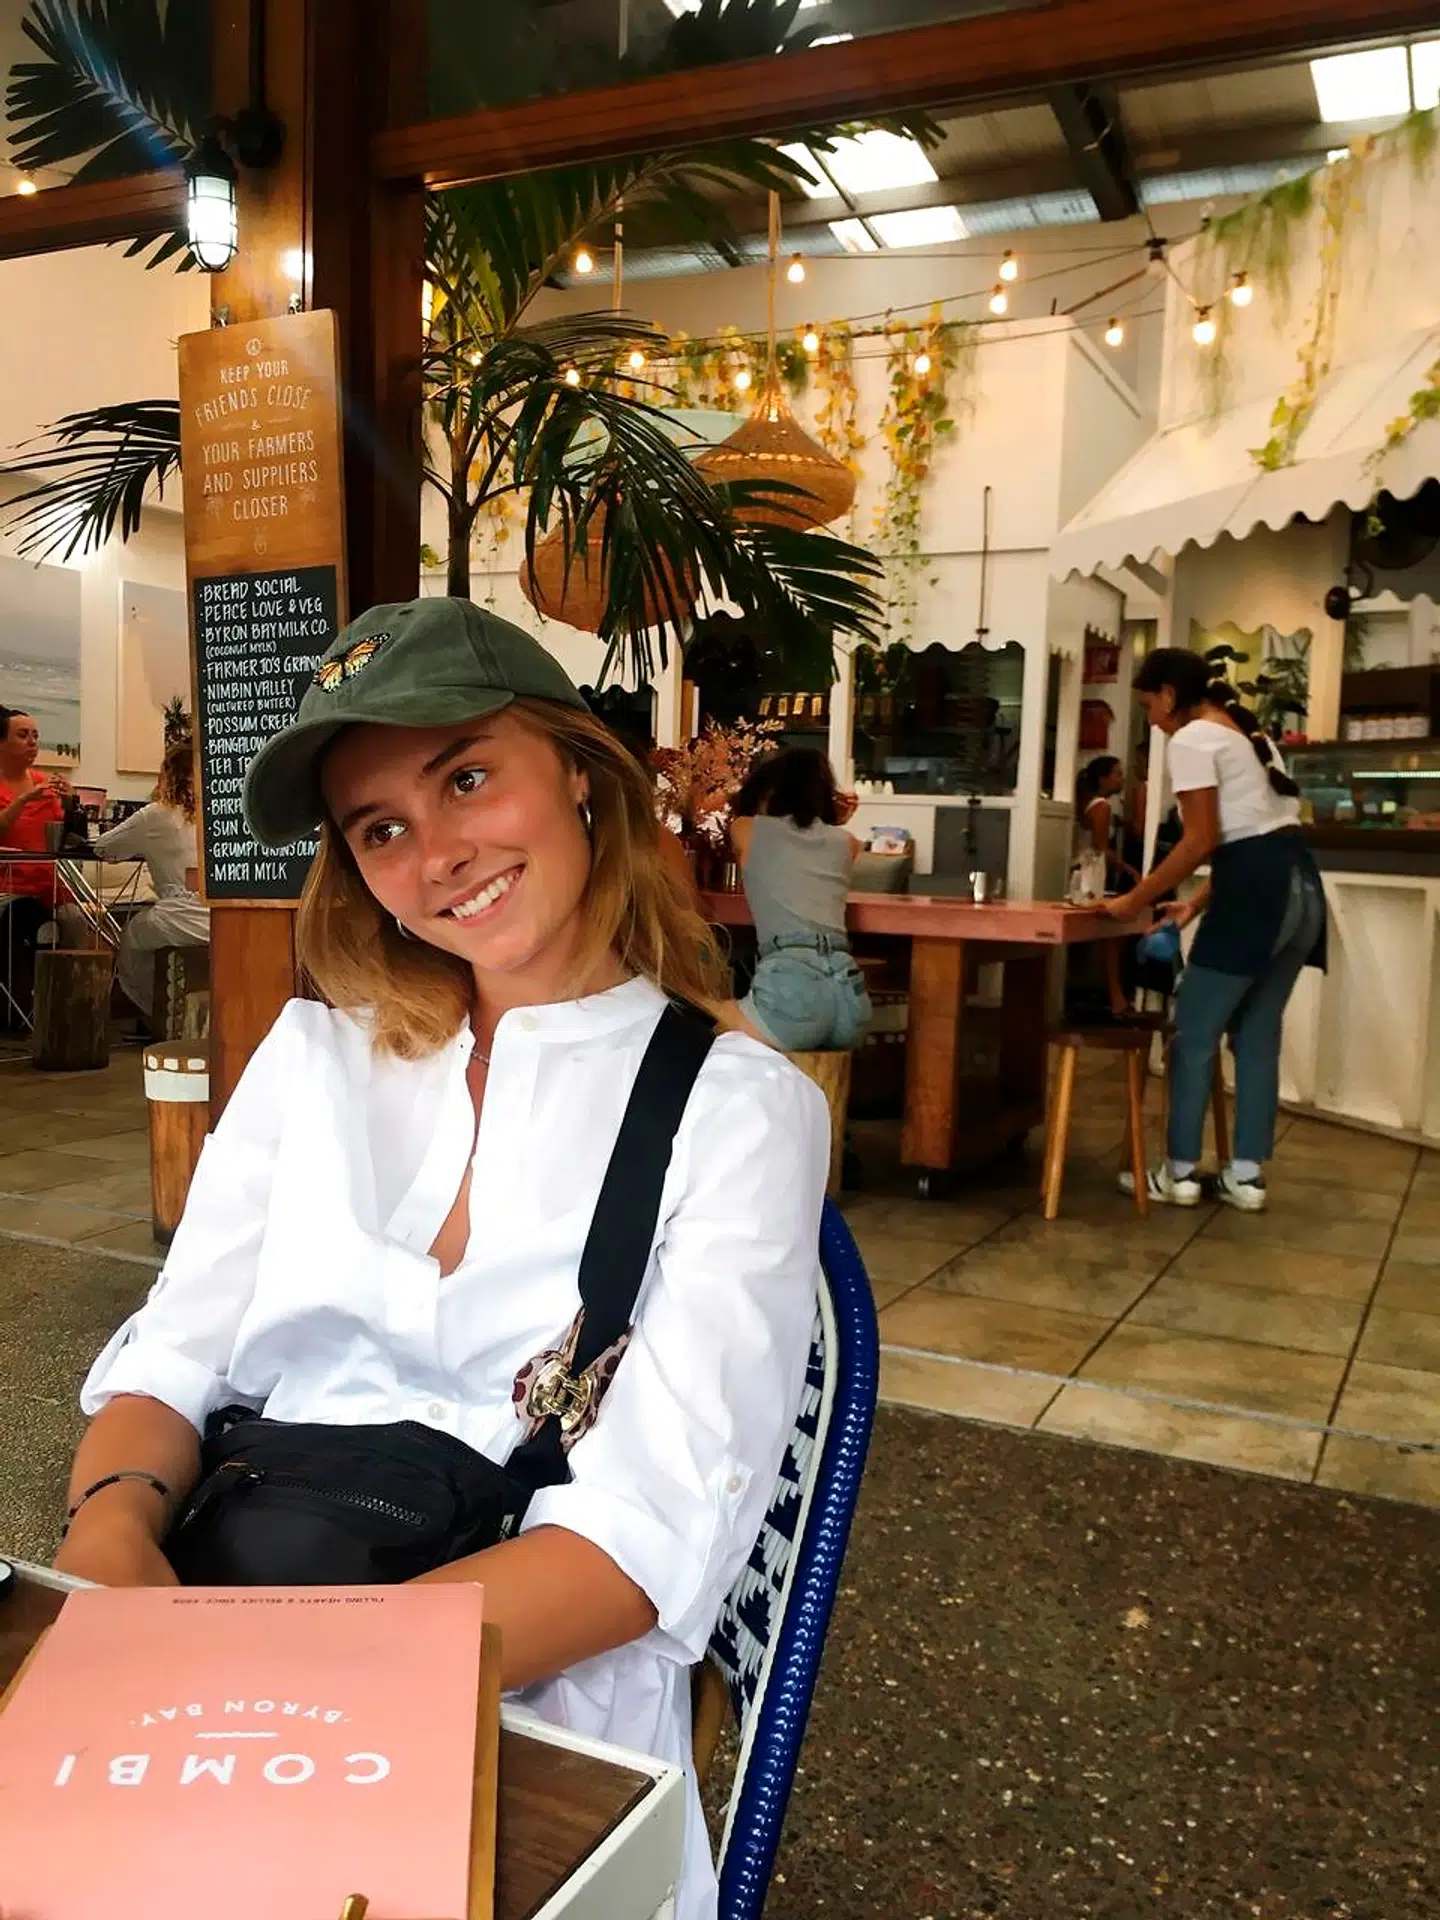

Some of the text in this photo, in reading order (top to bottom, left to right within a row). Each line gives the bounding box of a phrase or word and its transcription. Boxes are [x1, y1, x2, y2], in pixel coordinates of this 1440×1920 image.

[219, 359, 289, 384] KEEP YOUR
[195, 385, 312, 427] FRIENDS CLOSE
[251, 419, 262, 430] &
[202, 431, 315, 465] YOUR FARMERS
[203, 460, 318, 494] AND SUPPLIERS
[233, 495, 288, 520] CLOSER
[204, 576, 301, 602] BREAD SOCIAL
[205, 597, 323, 623] PEACE LOVE & VEG
[205, 625, 248, 643] BYRON
[251, 622, 277, 640] BAY
[278, 620, 309, 638] MILK
[206, 655, 321, 680] FARMER JO'S GRANO
[207, 678, 296, 700] NIMBIN VALLEY
[208, 712, 300, 734] POSSUM CREEK
[208, 757, 232, 775] TEA
[212, 819, 239, 837] SUN
[213, 841, 259, 858] GRUMPY
[214, 862, 288, 882] MACA MYLK
[140, 1699, 346, 1728] BYRON BAY
[54, 1753, 391, 1785] COMBI
